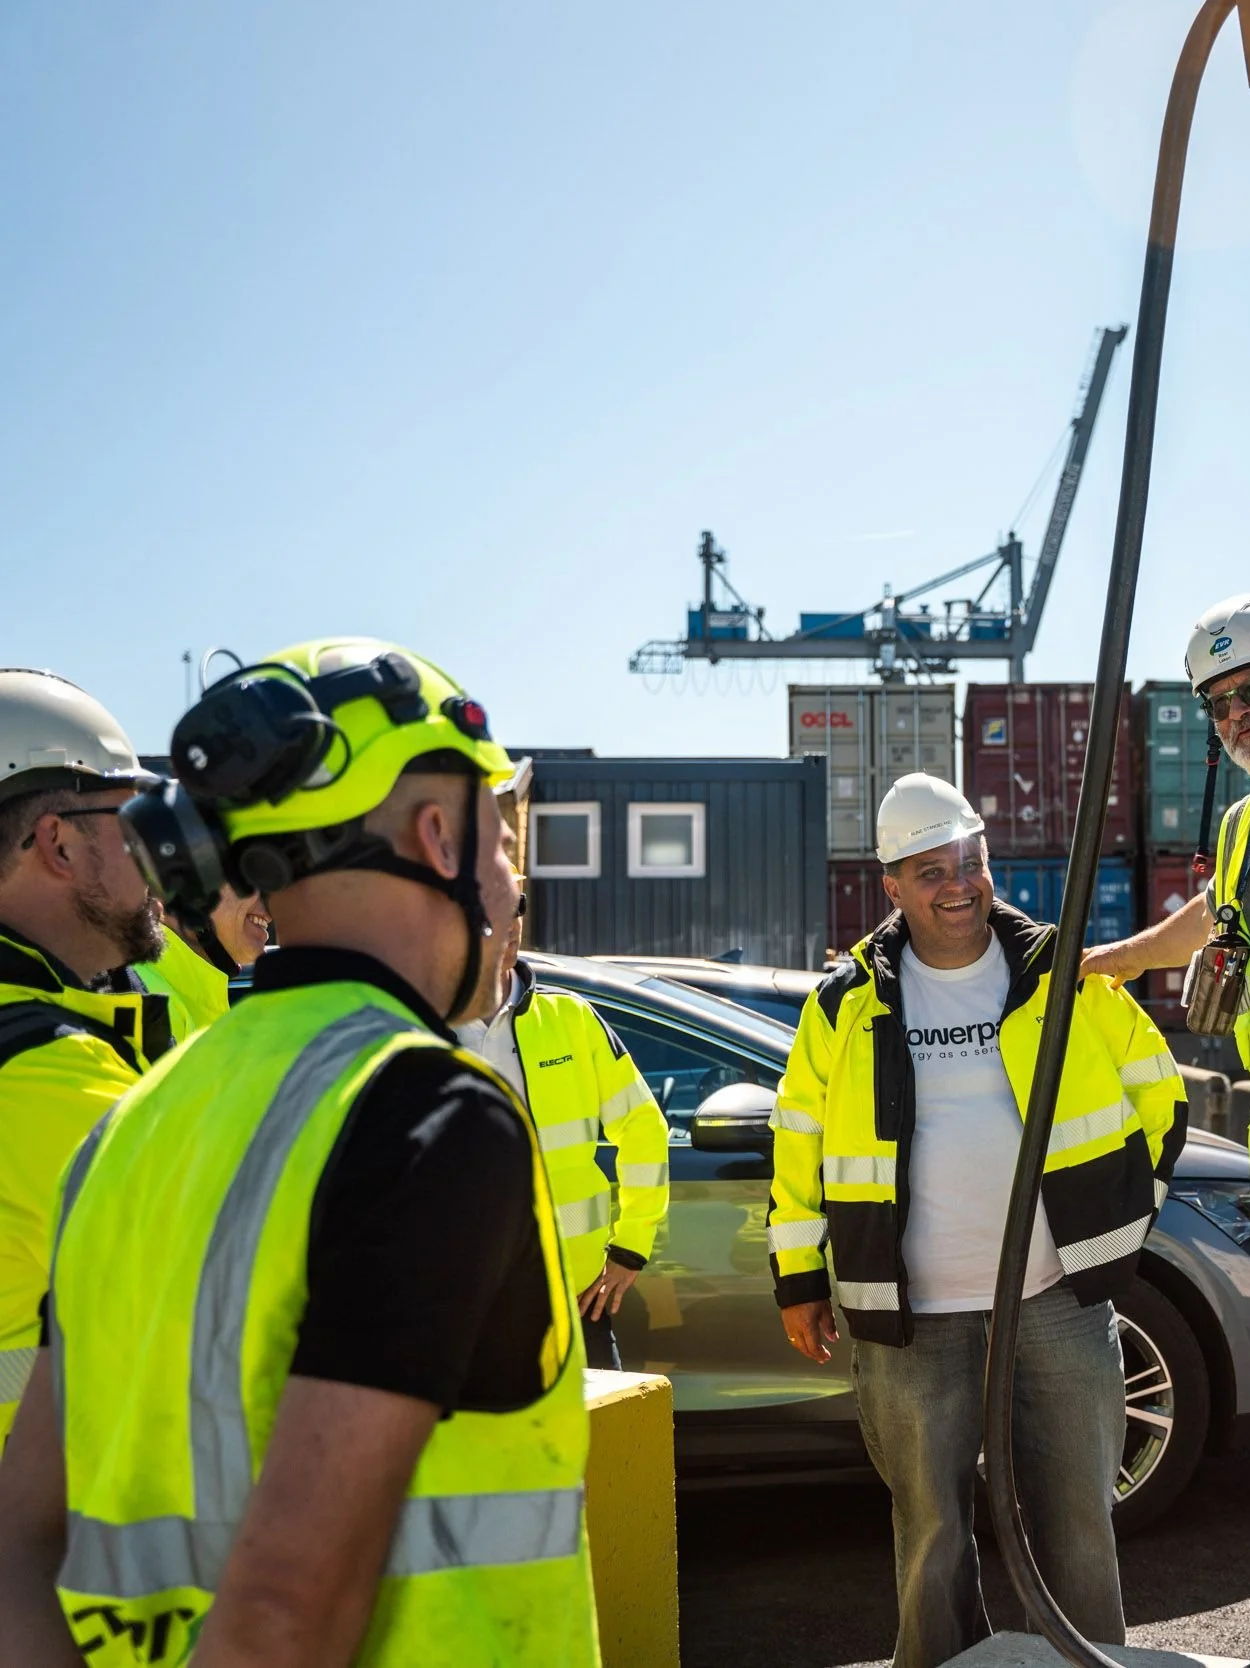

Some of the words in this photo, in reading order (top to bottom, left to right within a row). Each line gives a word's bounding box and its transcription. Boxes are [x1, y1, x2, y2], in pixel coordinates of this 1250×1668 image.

[1215, 639, 1230, 650] EVR
[938, 1050, 954, 1059] as
[960, 1050, 968, 1058] a
